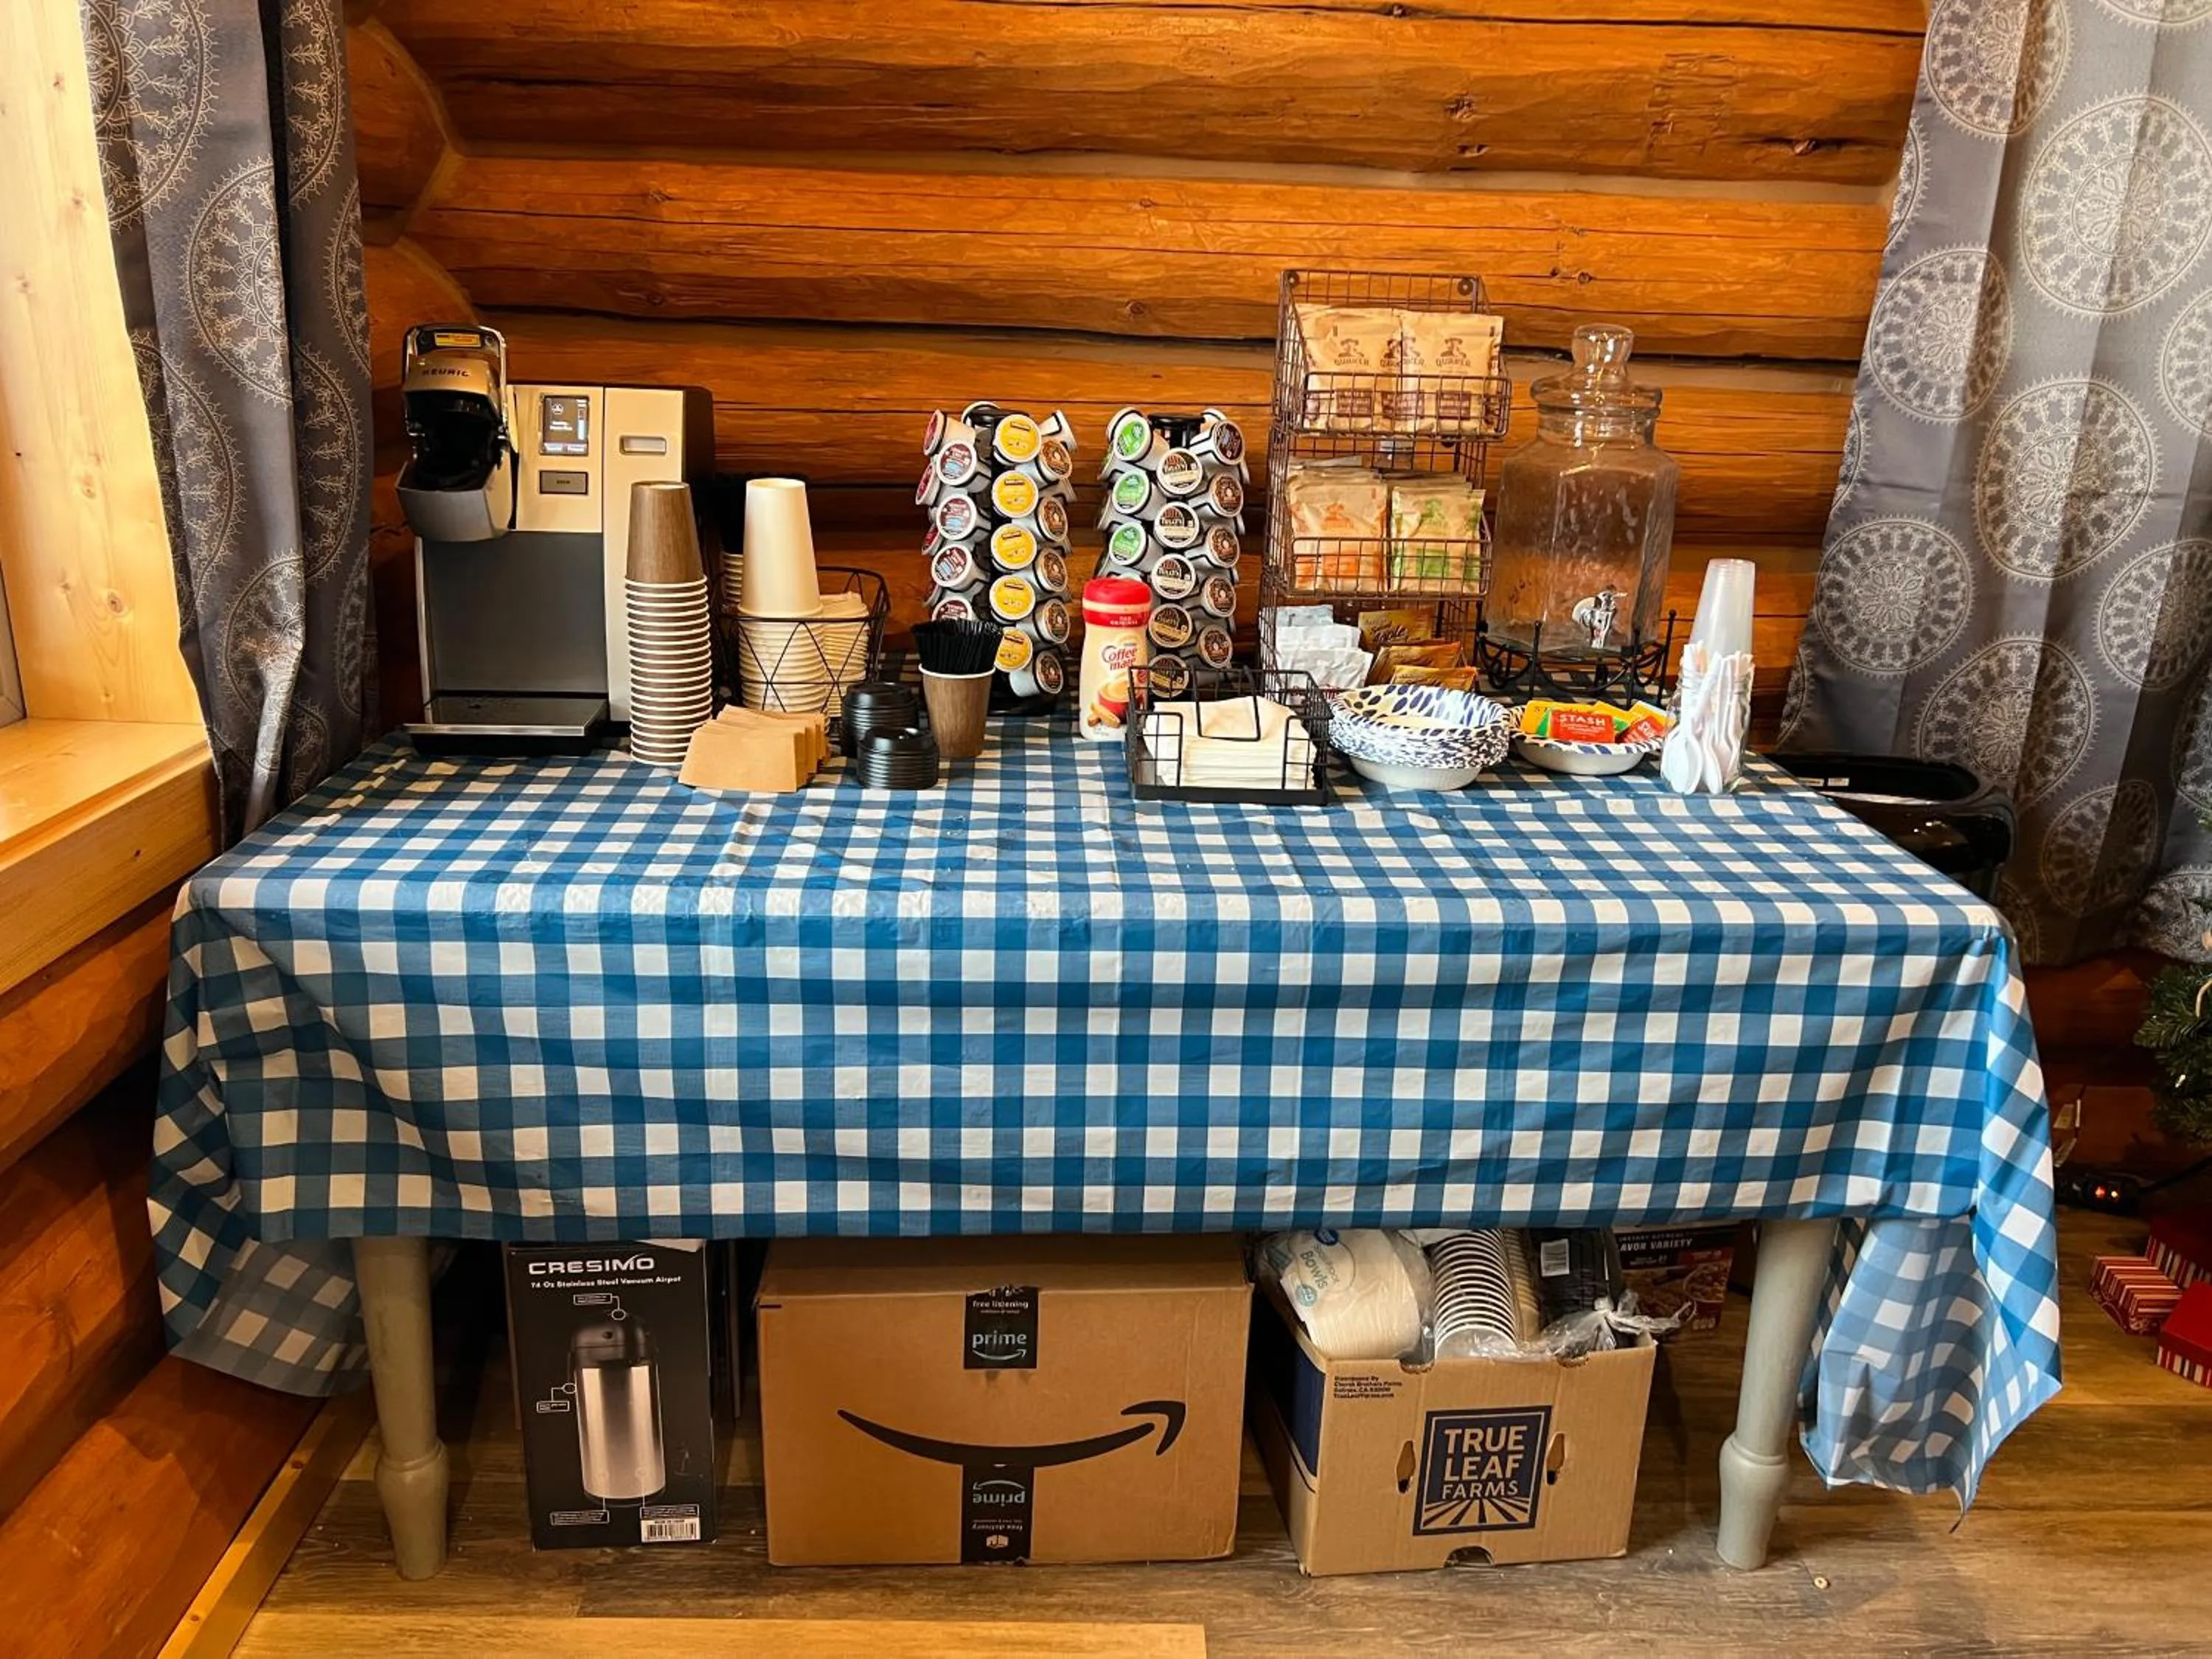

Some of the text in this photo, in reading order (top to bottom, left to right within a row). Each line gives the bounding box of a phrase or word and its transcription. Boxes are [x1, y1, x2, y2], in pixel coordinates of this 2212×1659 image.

[422, 369, 470, 377] KEURIG
[1102, 645, 1138, 664] Coffee
[1559, 714, 1606, 726] STASH
[1620, 1238, 1693, 1251] AVOR VARIETY
[529, 1253, 655, 1275] CRESIMO
[1300, 1250, 1328, 1289] Bowls
[557, 1279, 595, 1287] Stainless
[597, 1278, 619, 1286] Steel
[621, 1276, 654, 1284] Vacuum
[656, 1276, 681, 1284] Airpot
[992, 1301, 1029, 1310] listening
[973, 1329, 1027, 1349] prime
[1444, 1425, 1528, 1454] TRUE
[1444, 1454, 1524, 1481] LEAF
[973, 1490, 1026, 1506] prime
[1441, 1480, 1518, 1500] FARMS
